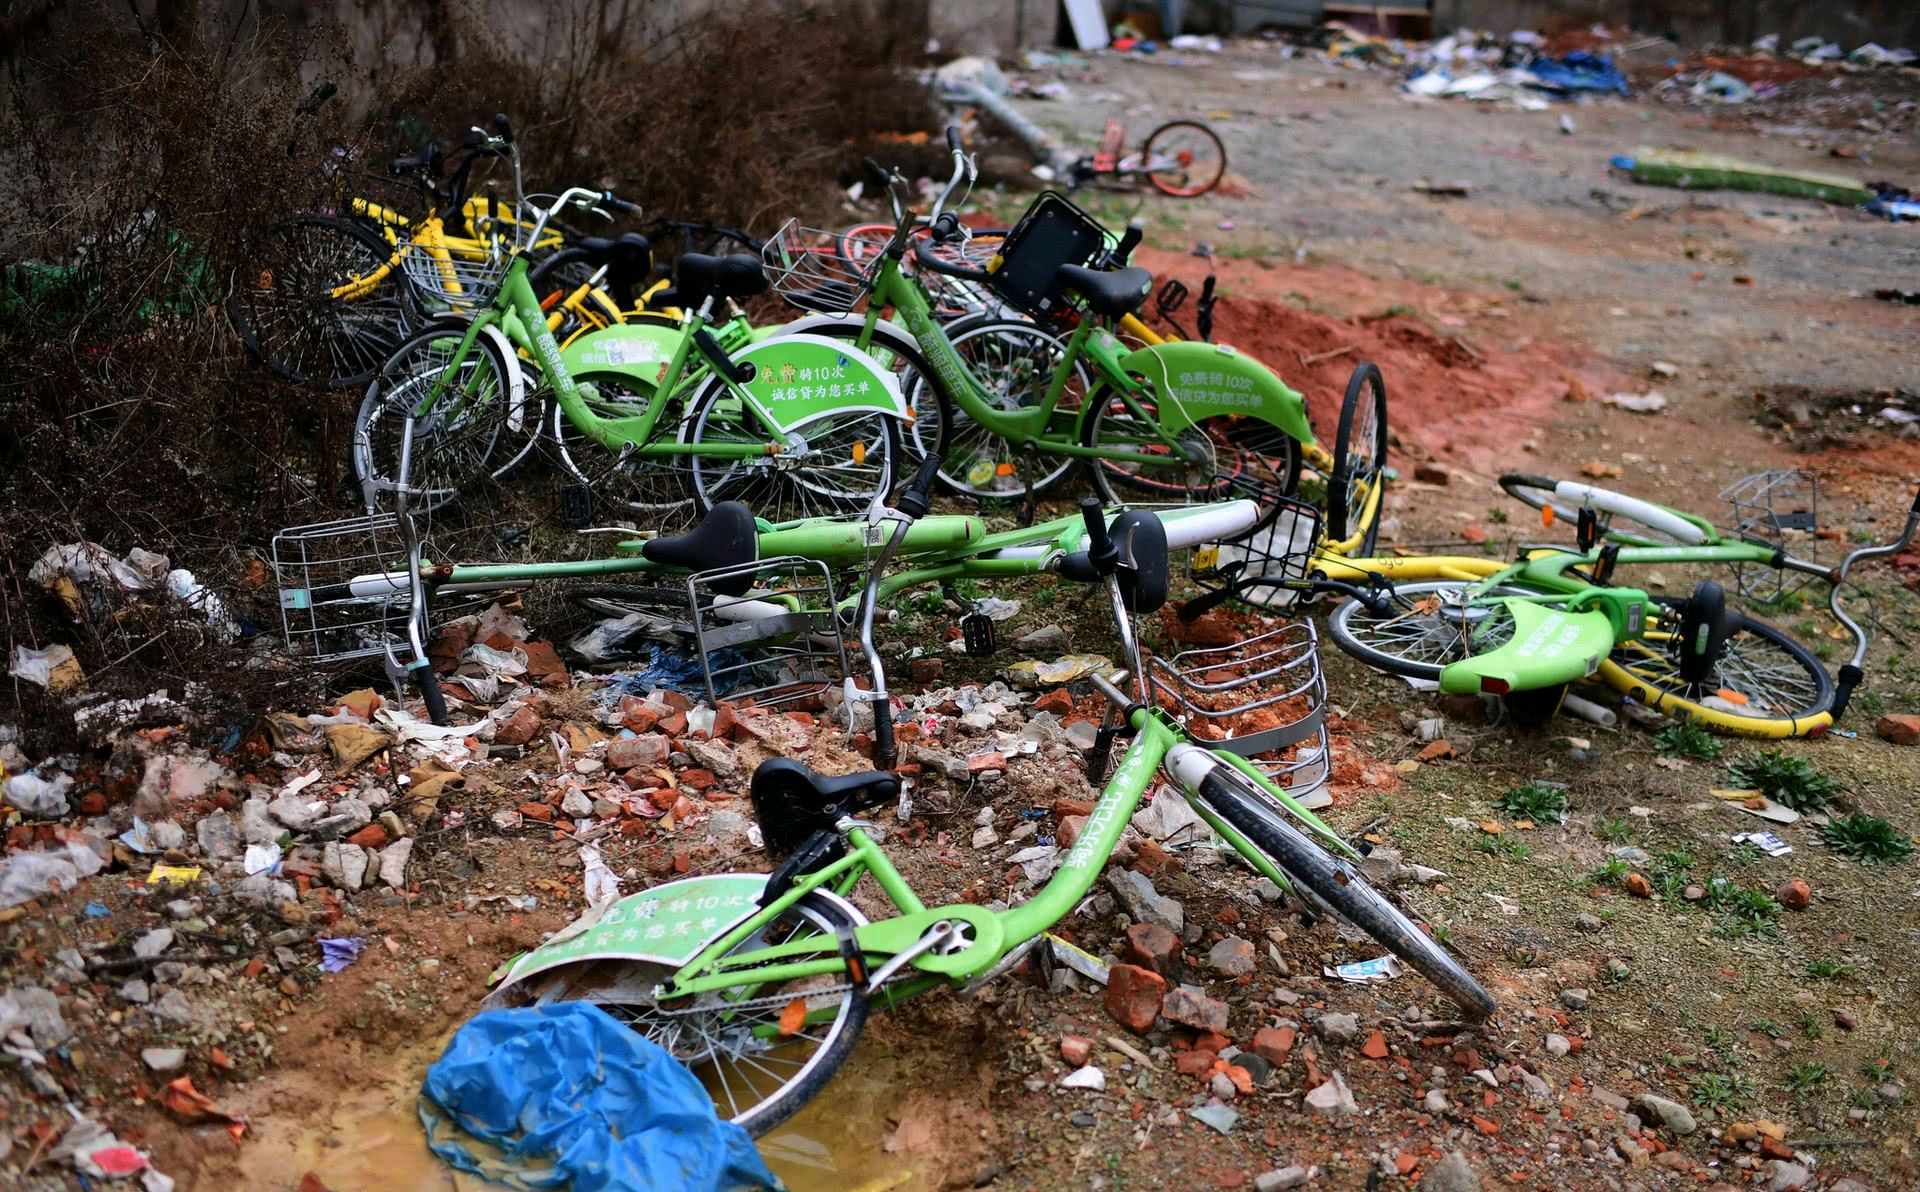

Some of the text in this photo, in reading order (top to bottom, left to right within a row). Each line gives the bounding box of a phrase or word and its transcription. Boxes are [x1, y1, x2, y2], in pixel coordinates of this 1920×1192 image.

[918, 332, 969, 398] 酷骑单车
[770, 381, 871, 401] 诚信贷为您买单
